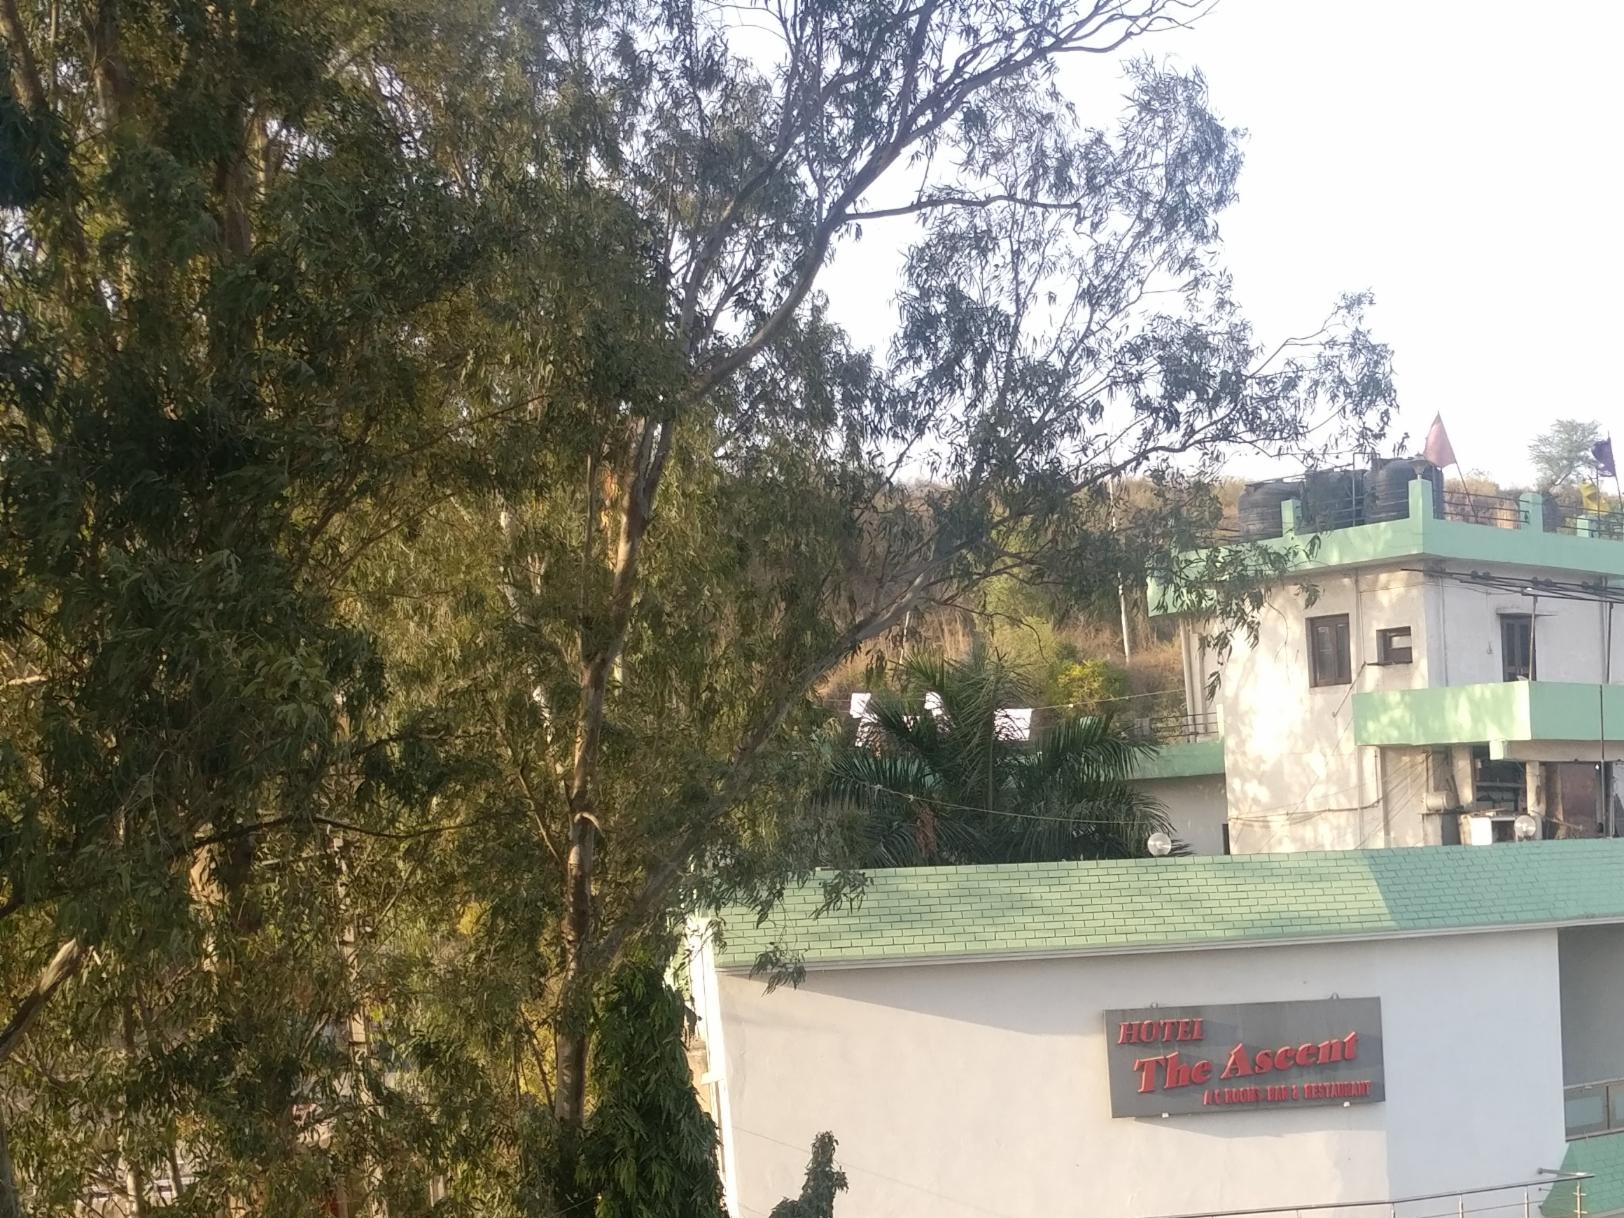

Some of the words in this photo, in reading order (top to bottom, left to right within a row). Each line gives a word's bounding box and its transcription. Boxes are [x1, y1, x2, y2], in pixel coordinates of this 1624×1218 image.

[1117, 1018, 1204, 1044] HOTEL
[1133, 1051, 1213, 1093] The
[1220, 1031, 1360, 1080] Ascent
[1266, 1084, 1288, 1102] BAR
[1304, 1080, 1372, 1099] RESTAURANT
